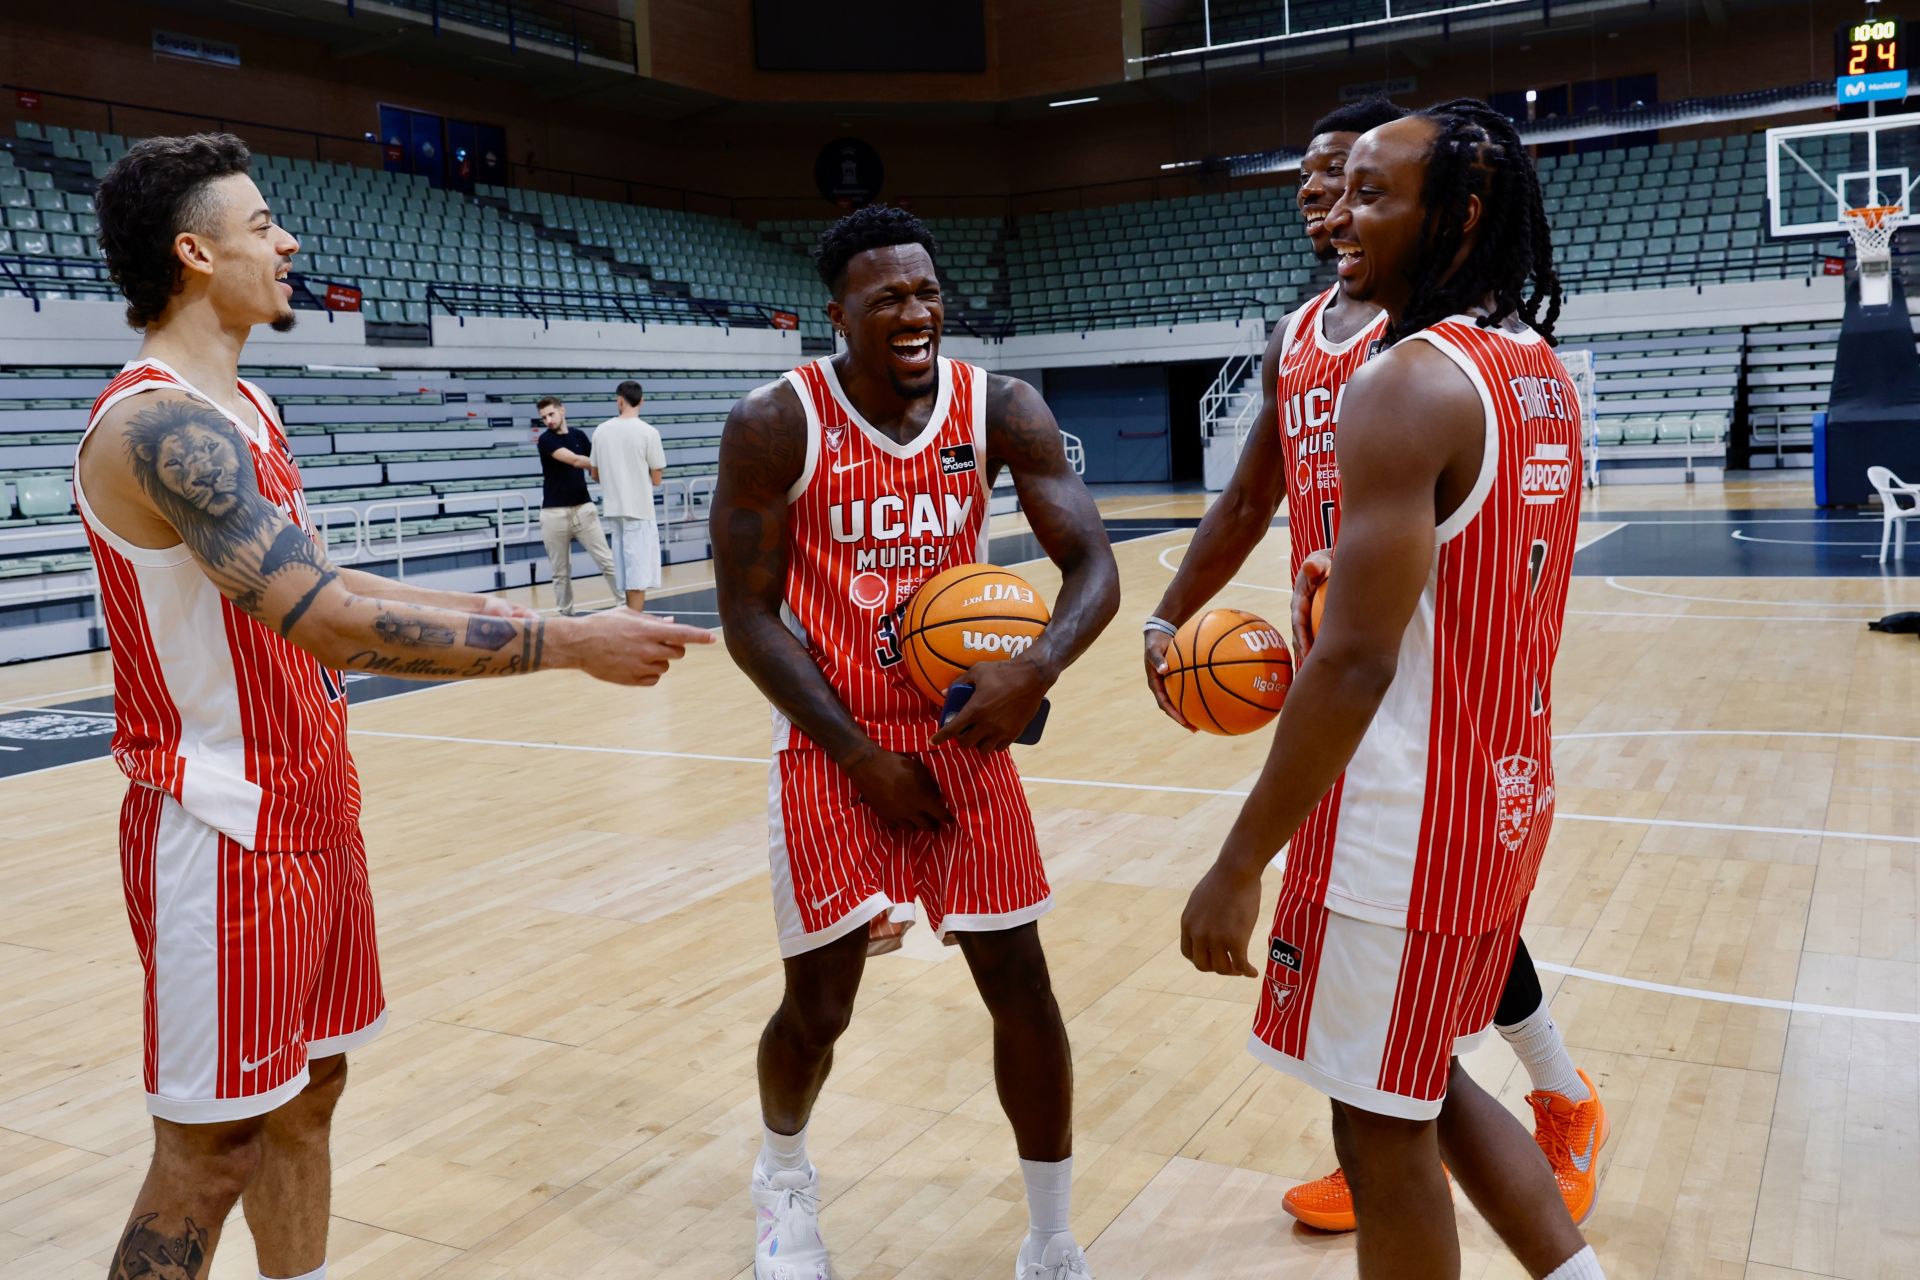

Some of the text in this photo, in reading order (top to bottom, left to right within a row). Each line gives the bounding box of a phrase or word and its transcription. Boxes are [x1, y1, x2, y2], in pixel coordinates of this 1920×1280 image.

[1854, 22, 1895, 42] 10:00
[1848, 42, 1896, 75] 24
[943, 460, 974, 472] endesa
[1317, 479, 1329, 489] DE
[829, 493, 974, 544] UCAM
[1272, 949, 1295, 966] acb
